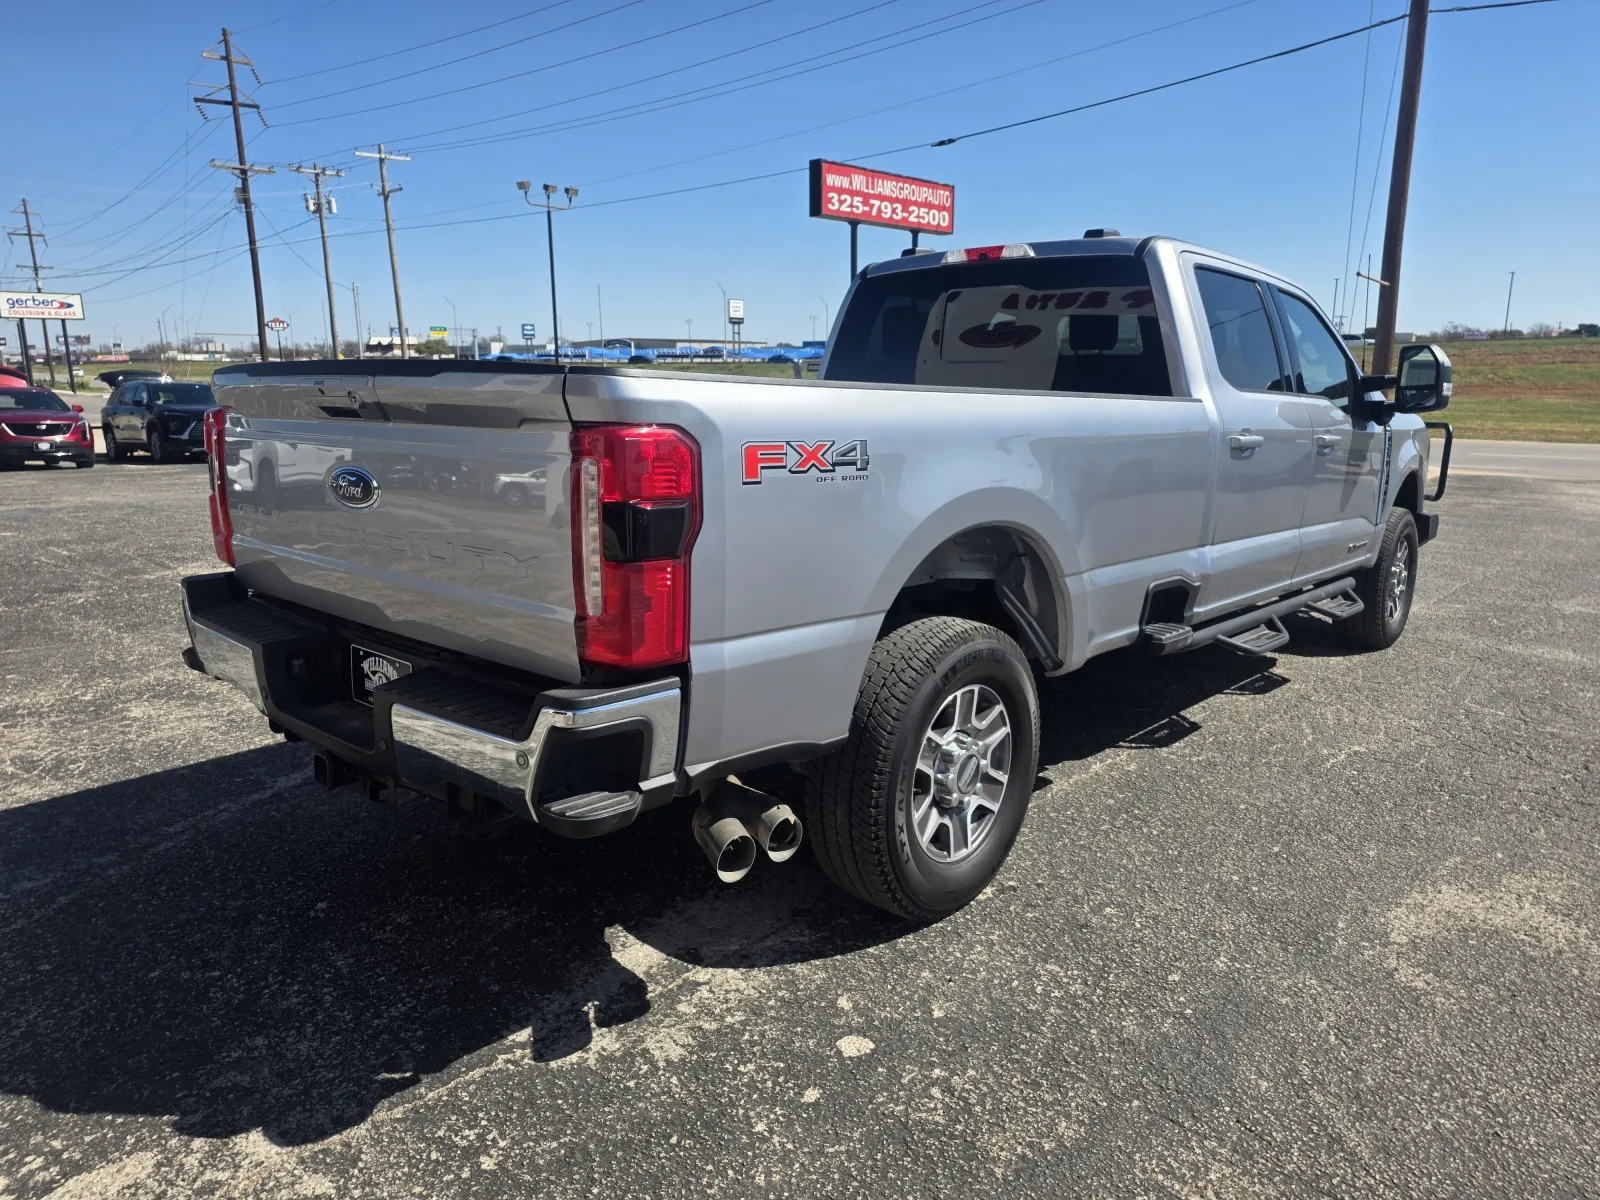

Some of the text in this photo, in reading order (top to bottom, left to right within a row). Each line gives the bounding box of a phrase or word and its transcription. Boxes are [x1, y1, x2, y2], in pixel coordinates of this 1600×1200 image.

[827, 192, 949, 227] 325-793-2500
[6, 295, 58, 309] gerber
[741, 439, 869, 486] FX4
[338, 474, 364, 499] Ford
[816, 474, 869, 483] OFF ROAD
